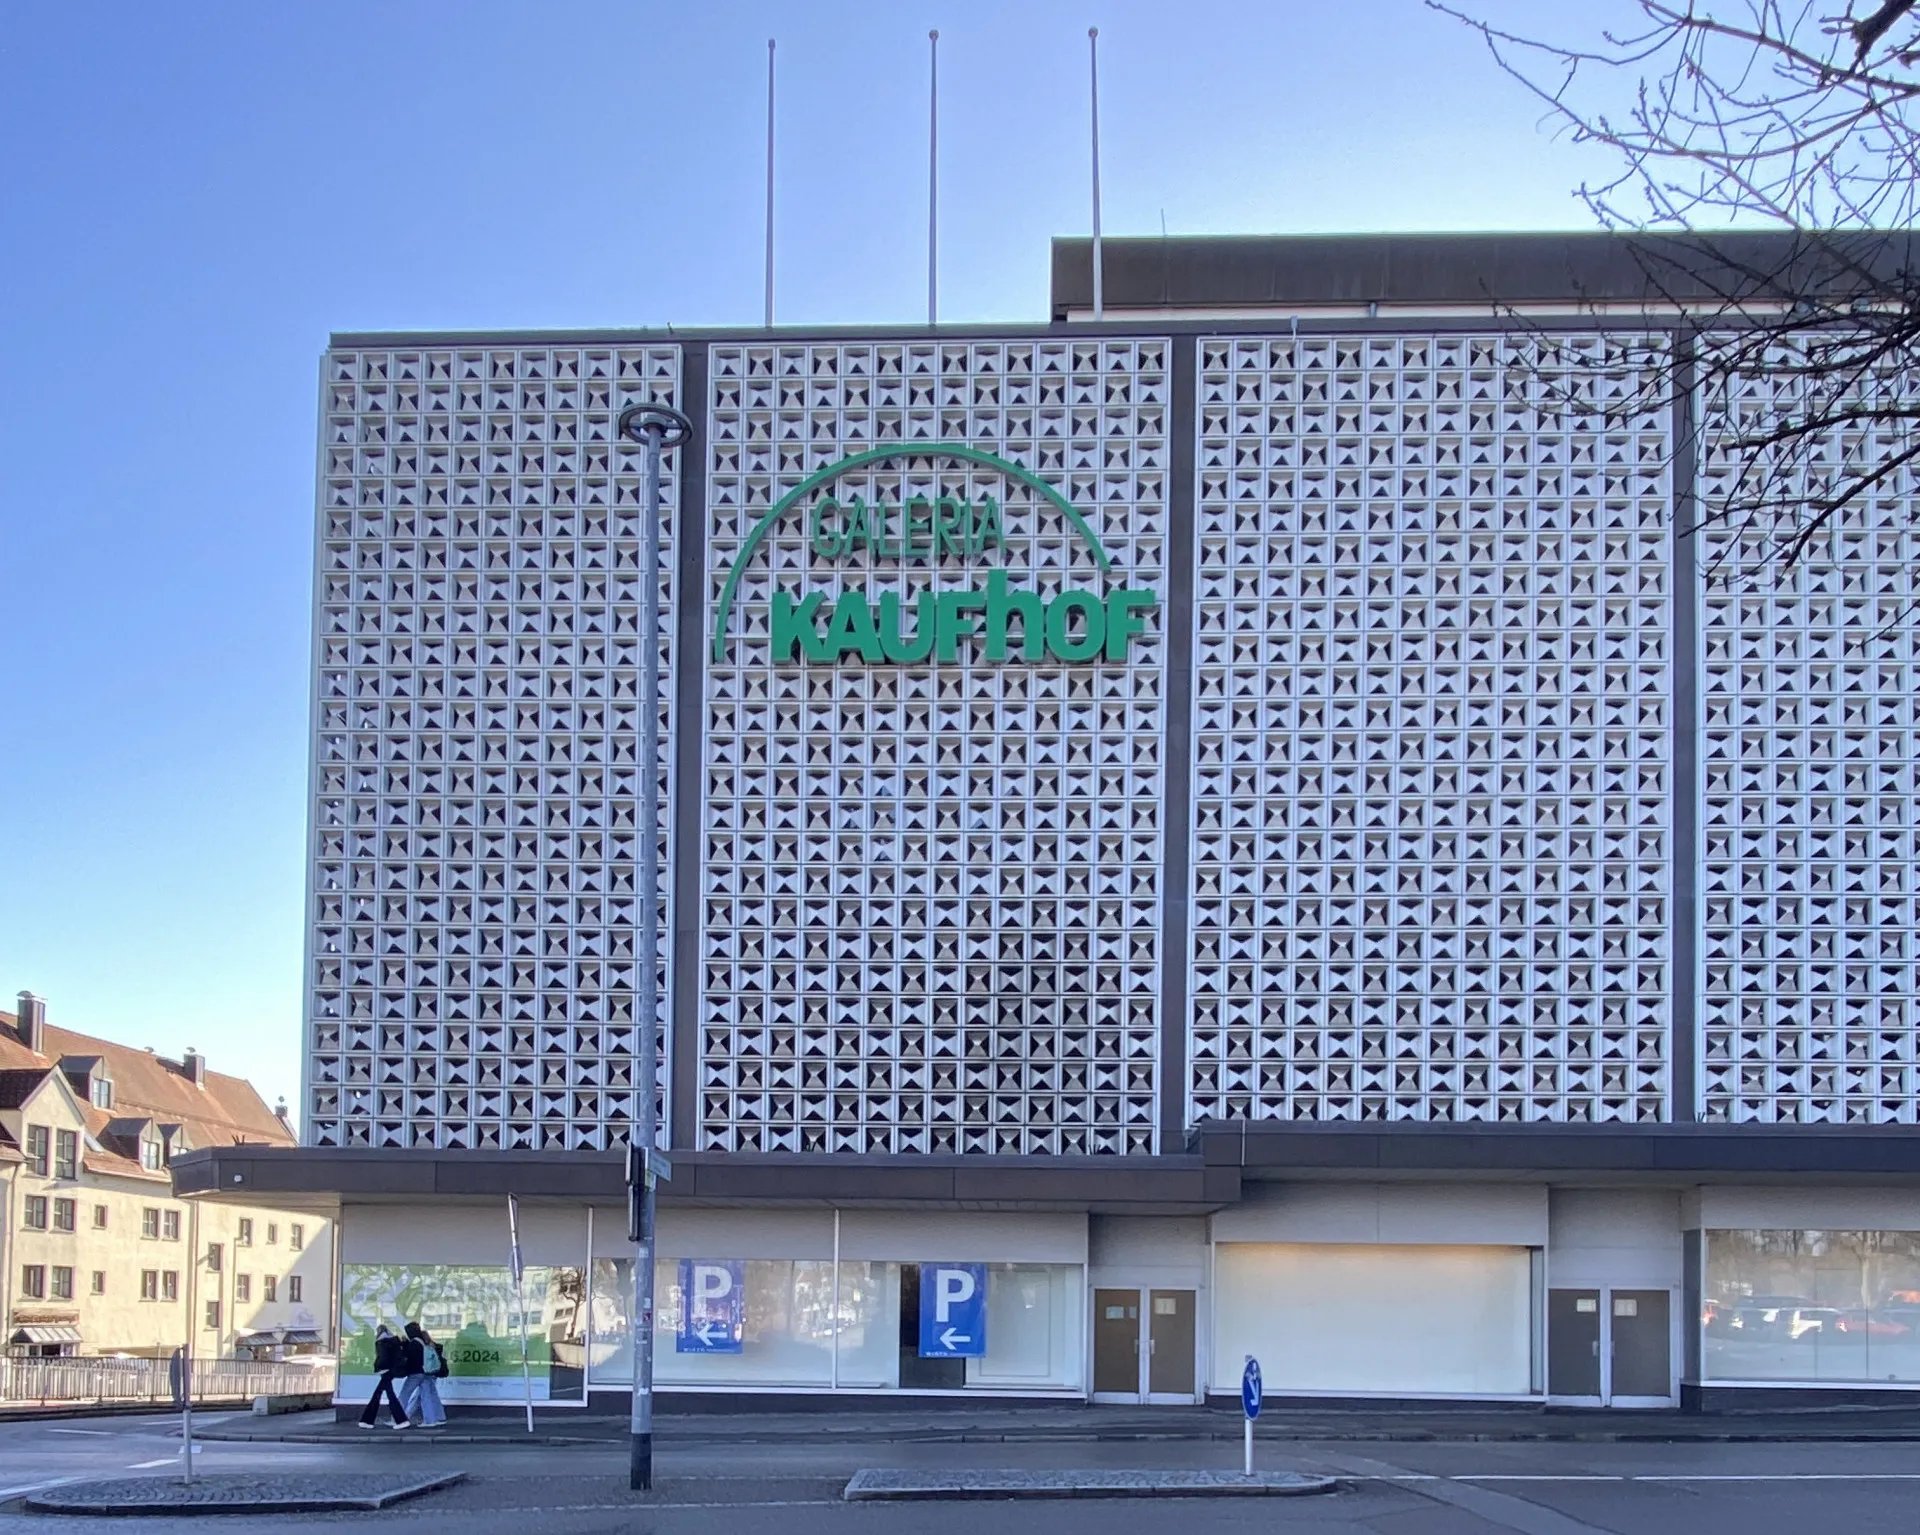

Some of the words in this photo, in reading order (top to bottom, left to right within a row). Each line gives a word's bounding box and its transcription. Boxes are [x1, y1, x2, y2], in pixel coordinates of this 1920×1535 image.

[811, 496, 1005, 559] GALERIA
[694, 1265, 733, 1319] P
[936, 1269, 975, 1322] P
